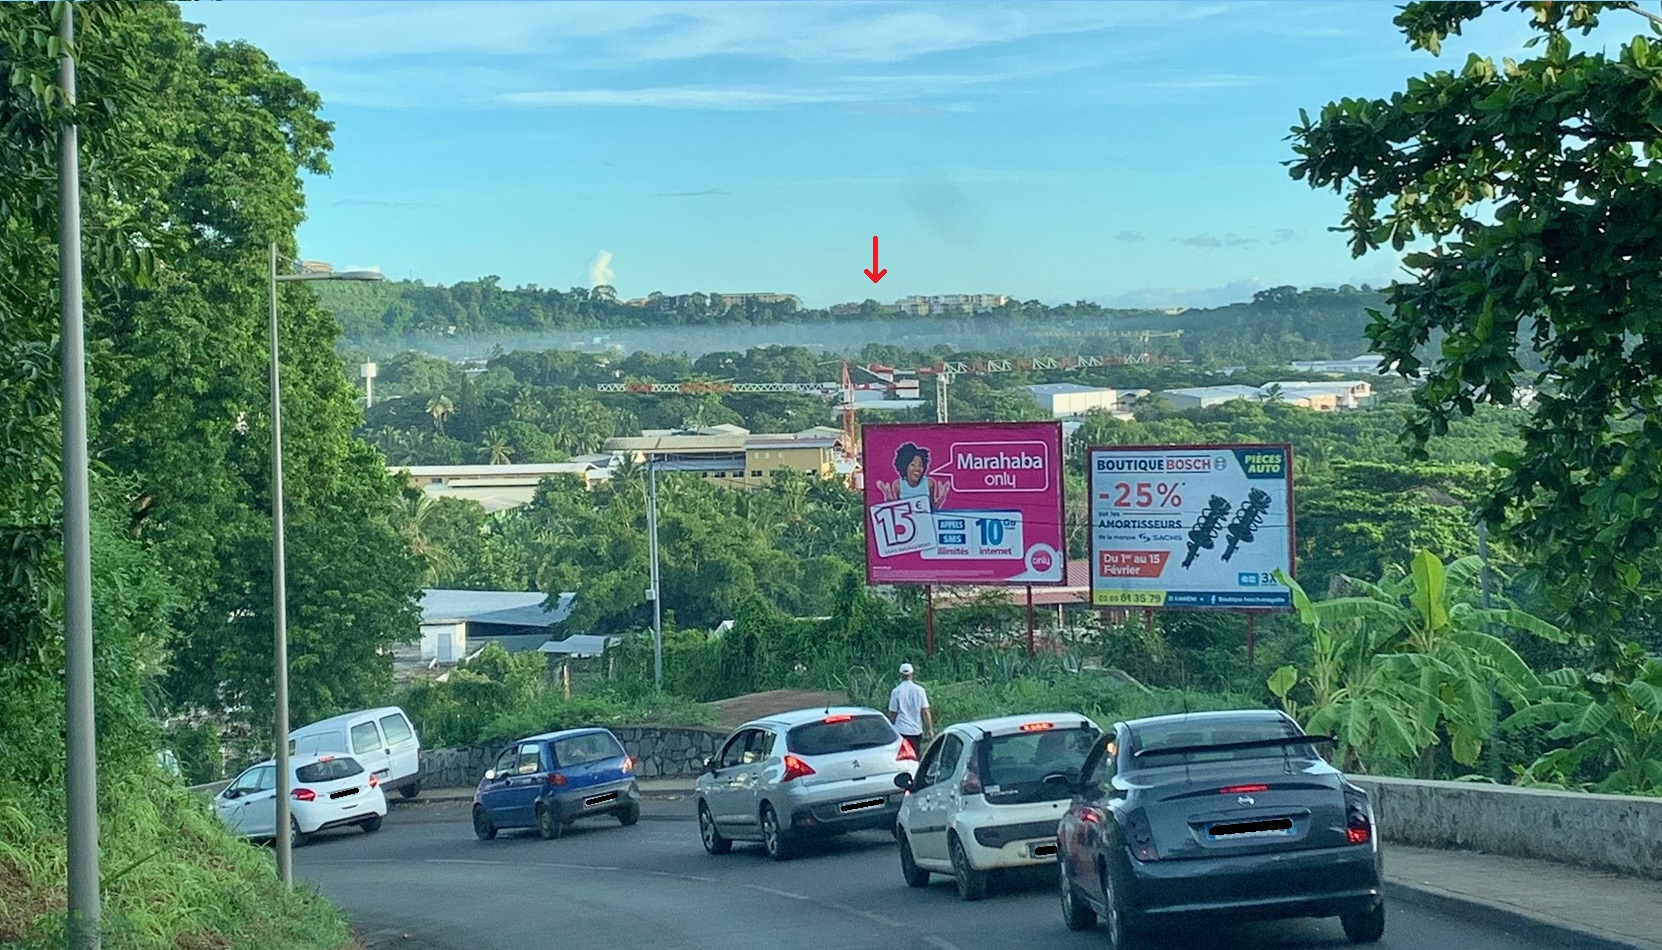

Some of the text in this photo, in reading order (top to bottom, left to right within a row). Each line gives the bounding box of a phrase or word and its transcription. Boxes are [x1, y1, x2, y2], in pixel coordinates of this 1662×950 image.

[957, 452, 1043, 470] Marahaba
[1244, 453, 1282, 464] PIÈCES
[1096, 458, 1211, 471] BOUTIQUE BOSCH
[1248, 464, 1280, 474] AUTO
[984, 472, 1016, 488] only
[939, 520, 964, 529] APPELS
[1098, 519, 1183, 529] AMORTISSEURS
[942, 535, 962, 543] SMS
[1032, 556, 1050, 566] only
[1103, 554, 1118, 563] Du
[1133, 555, 1147, 563] au
[1149, 554, 1161, 564] 15
[1103, 565, 1141, 575] Février
[1120, 594, 1131, 602] 61
[1132, 594, 1146, 602] 35
[1149, 594, 1162, 603] 79
